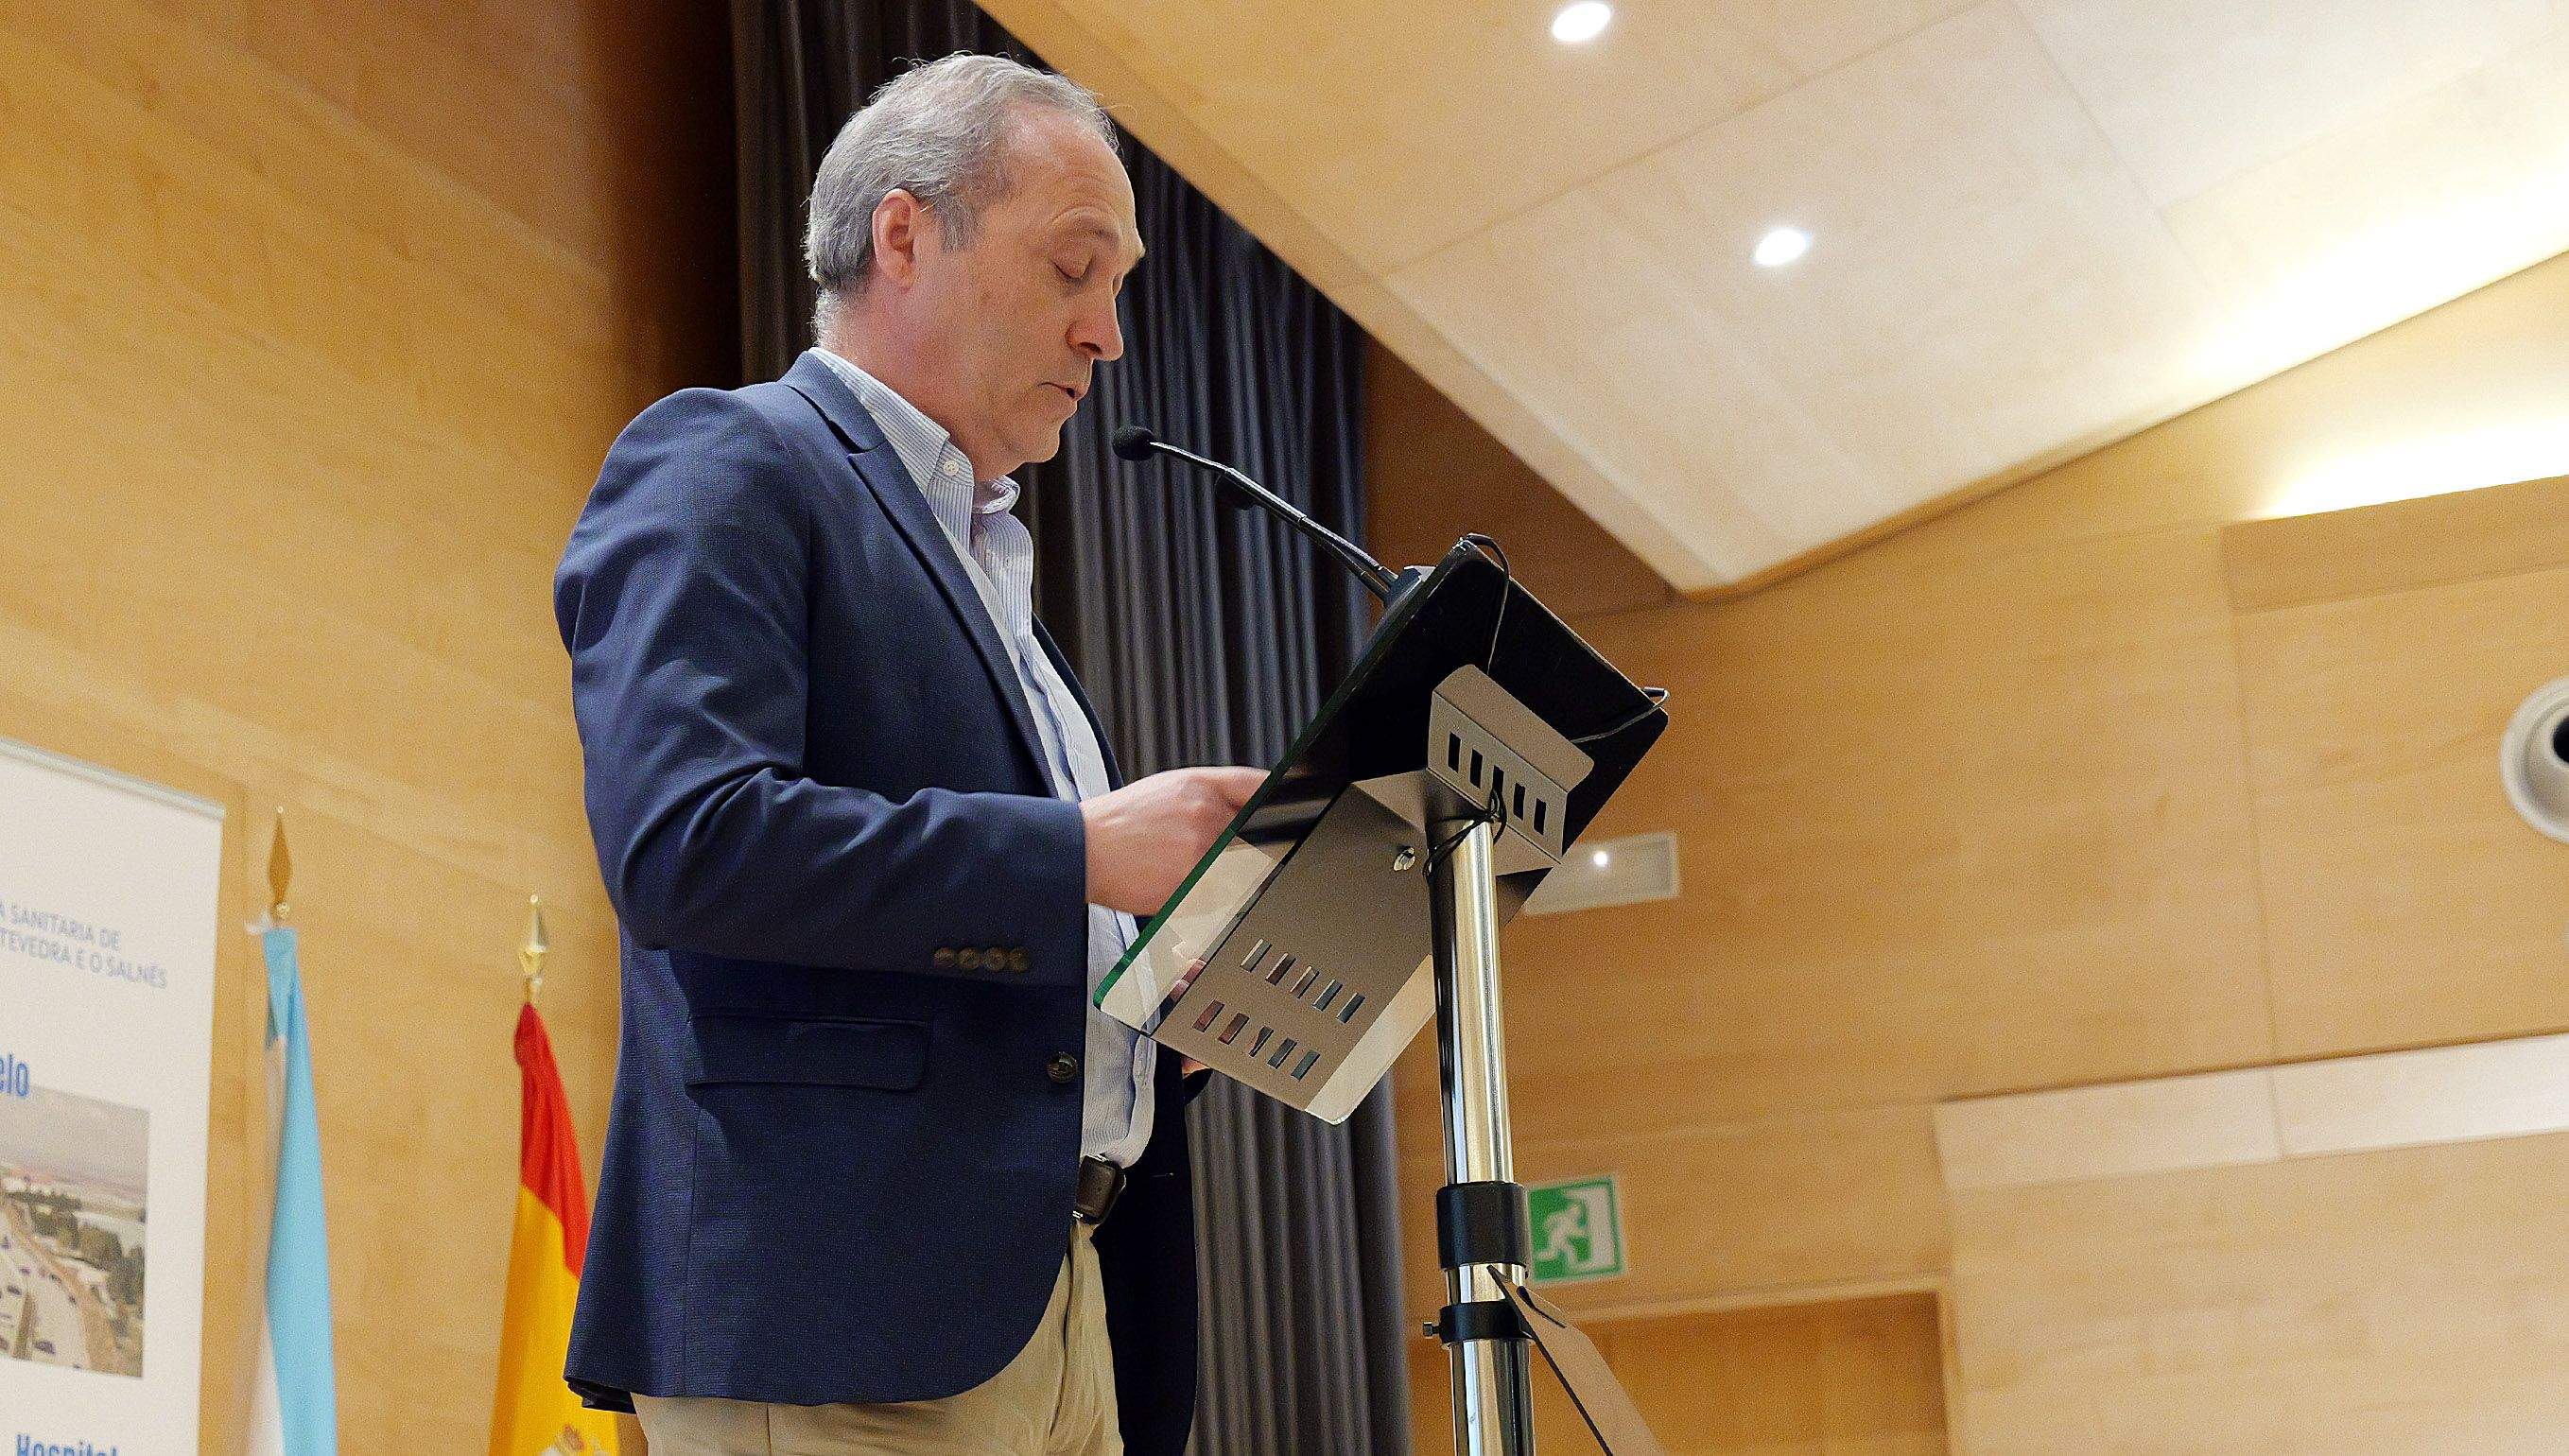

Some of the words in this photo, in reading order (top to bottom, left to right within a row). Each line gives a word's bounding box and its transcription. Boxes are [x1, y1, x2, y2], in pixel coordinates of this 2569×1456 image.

[10, 903, 94, 942] SANITARIA
[99, 927, 121, 952] DE
[75, 949, 85, 970] E
[89, 952, 103, 974] O
